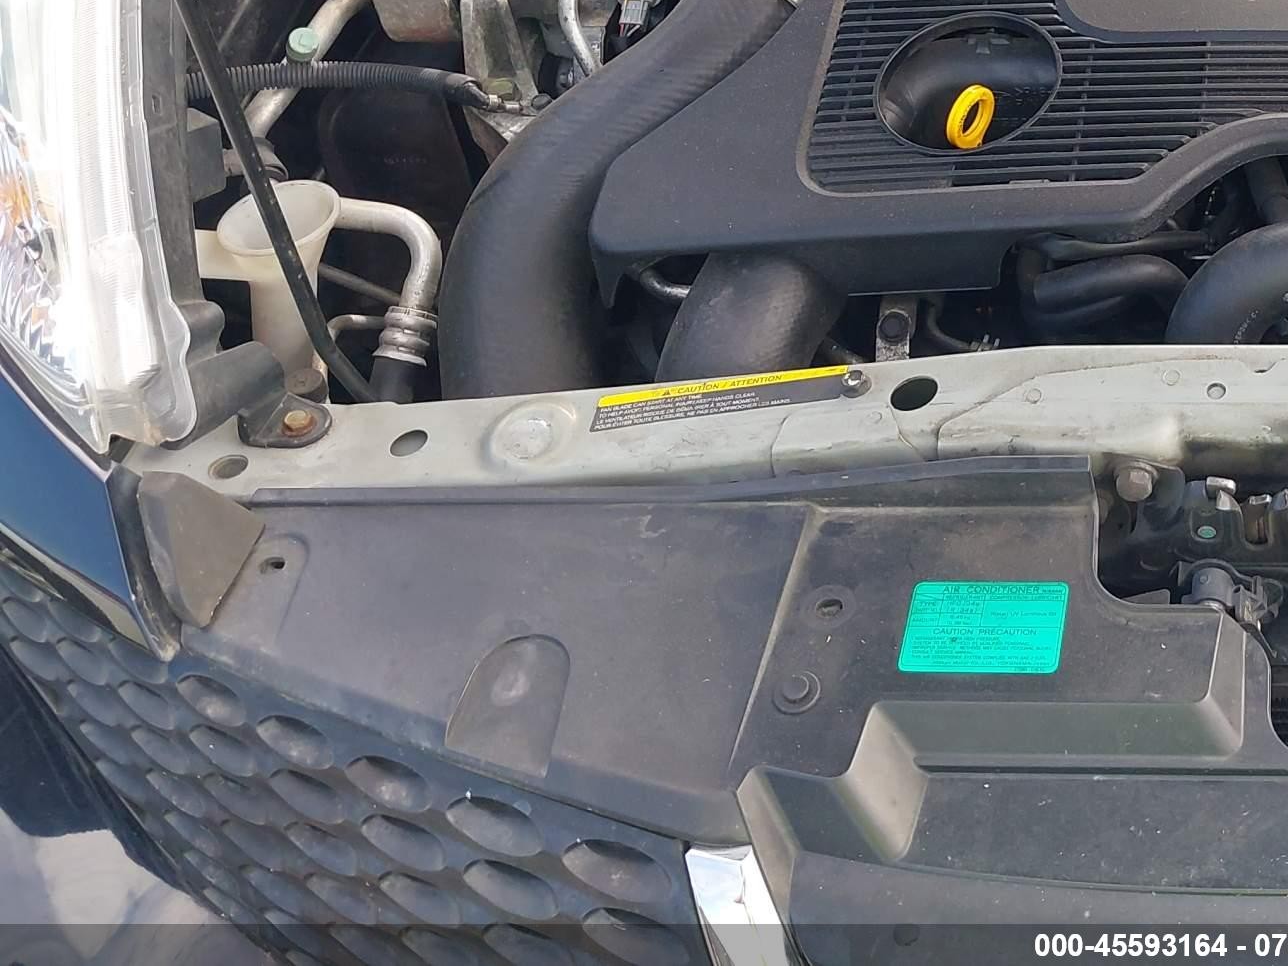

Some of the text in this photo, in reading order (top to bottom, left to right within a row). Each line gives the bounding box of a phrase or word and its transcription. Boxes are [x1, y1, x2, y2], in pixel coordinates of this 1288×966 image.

[677, 382, 719, 393] CAUTION
[728, 375, 782, 387] ATTENTION
[943, 586, 960, 594] AIR
[966, 585, 1040, 594] CONDITIONER
[933, 628, 974, 636] CAUTION
